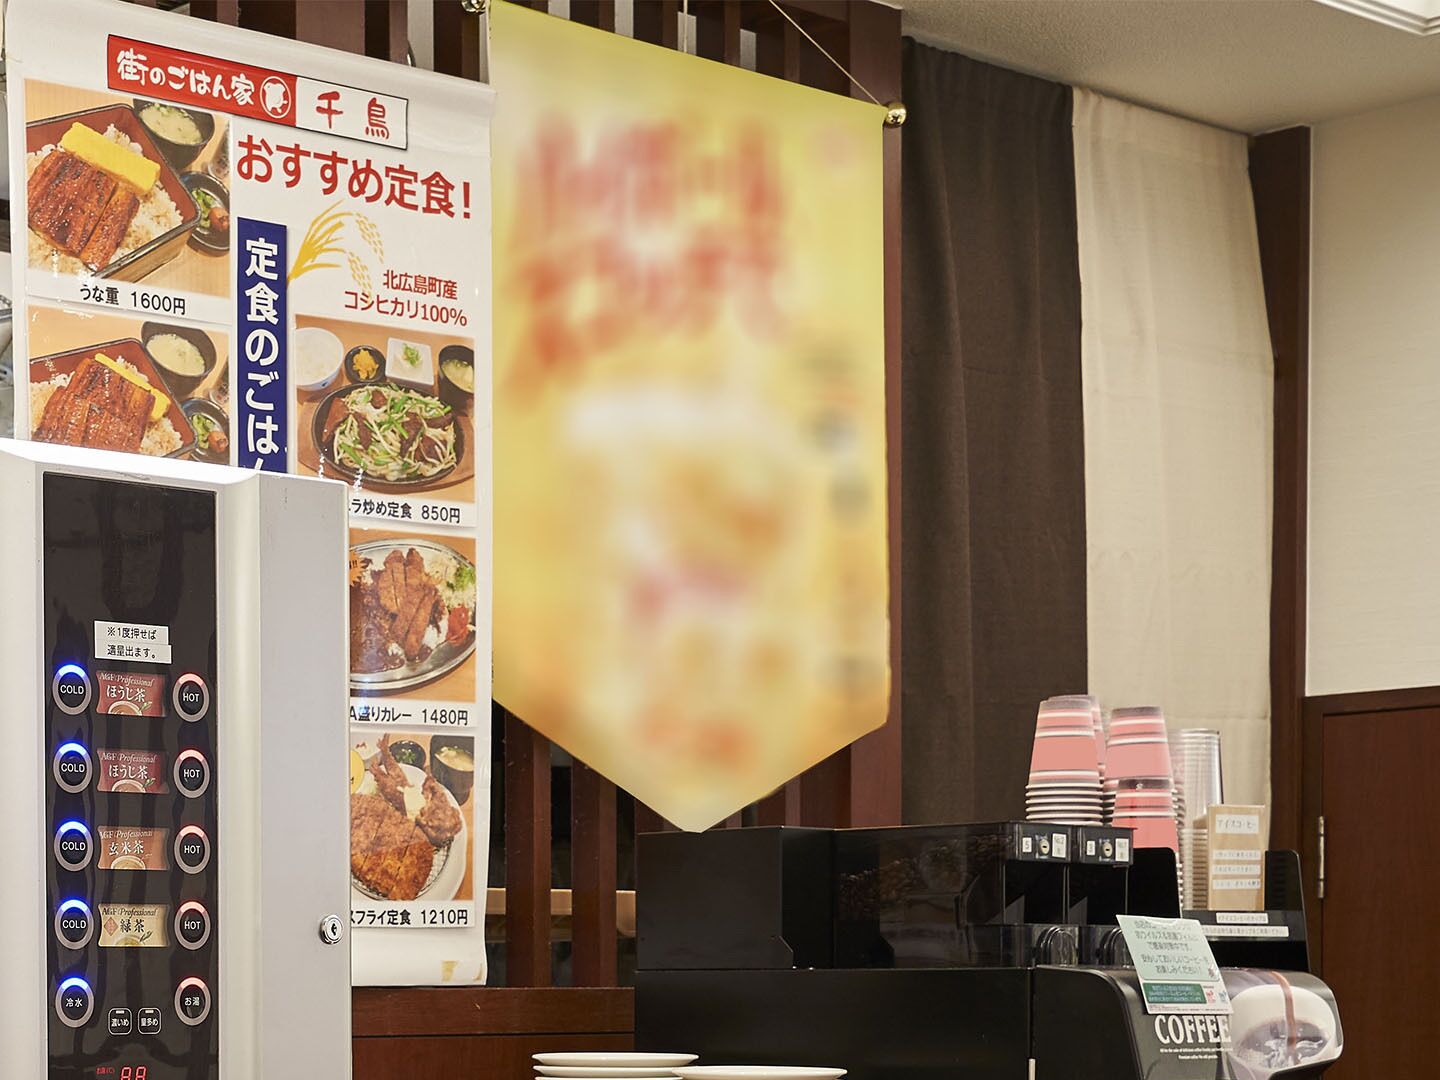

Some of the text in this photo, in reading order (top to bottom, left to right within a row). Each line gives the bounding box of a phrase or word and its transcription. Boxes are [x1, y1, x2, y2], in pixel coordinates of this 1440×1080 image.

[116, 47, 256, 106] 街のごはん家
[315, 90, 391, 141] 千鳥
[236, 134, 472, 220] おすすめ定食!
[382, 268, 458, 302] 北広島町産
[79, 283, 187, 316] うな重 1600円
[344, 289, 468, 327] コシヒカリ100%
[244, 237, 280, 471] 定食のごは
[348, 498, 461, 524] ラ炒め定食 850円
[107, 644, 156, 659] 適量出ます。
[60, 684, 85, 695] COLD
[106, 684, 146, 703] ほうじ茶
[182, 692, 200, 703] HOT
[421, 709, 469, 727] 1480円
[60, 762, 86, 773] COLD
[108, 764, 148, 780] ほうじ茶
[183, 768, 201, 779] HOT
[61, 841, 86, 852] COLD
[109, 842, 144, 857] 玄米茶
[183, 844, 201, 855] HOT
[420, 908, 469, 925] 1210円
[62, 920, 87, 930] COLD
[120, 919, 145, 933] 緑茶
[184, 921, 202, 931] HOT
[65, 997, 84, 1008] 冷水
[184, 995, 201, 1006] お湯
[1154, 1014, 1232, 1045] COFFEE
